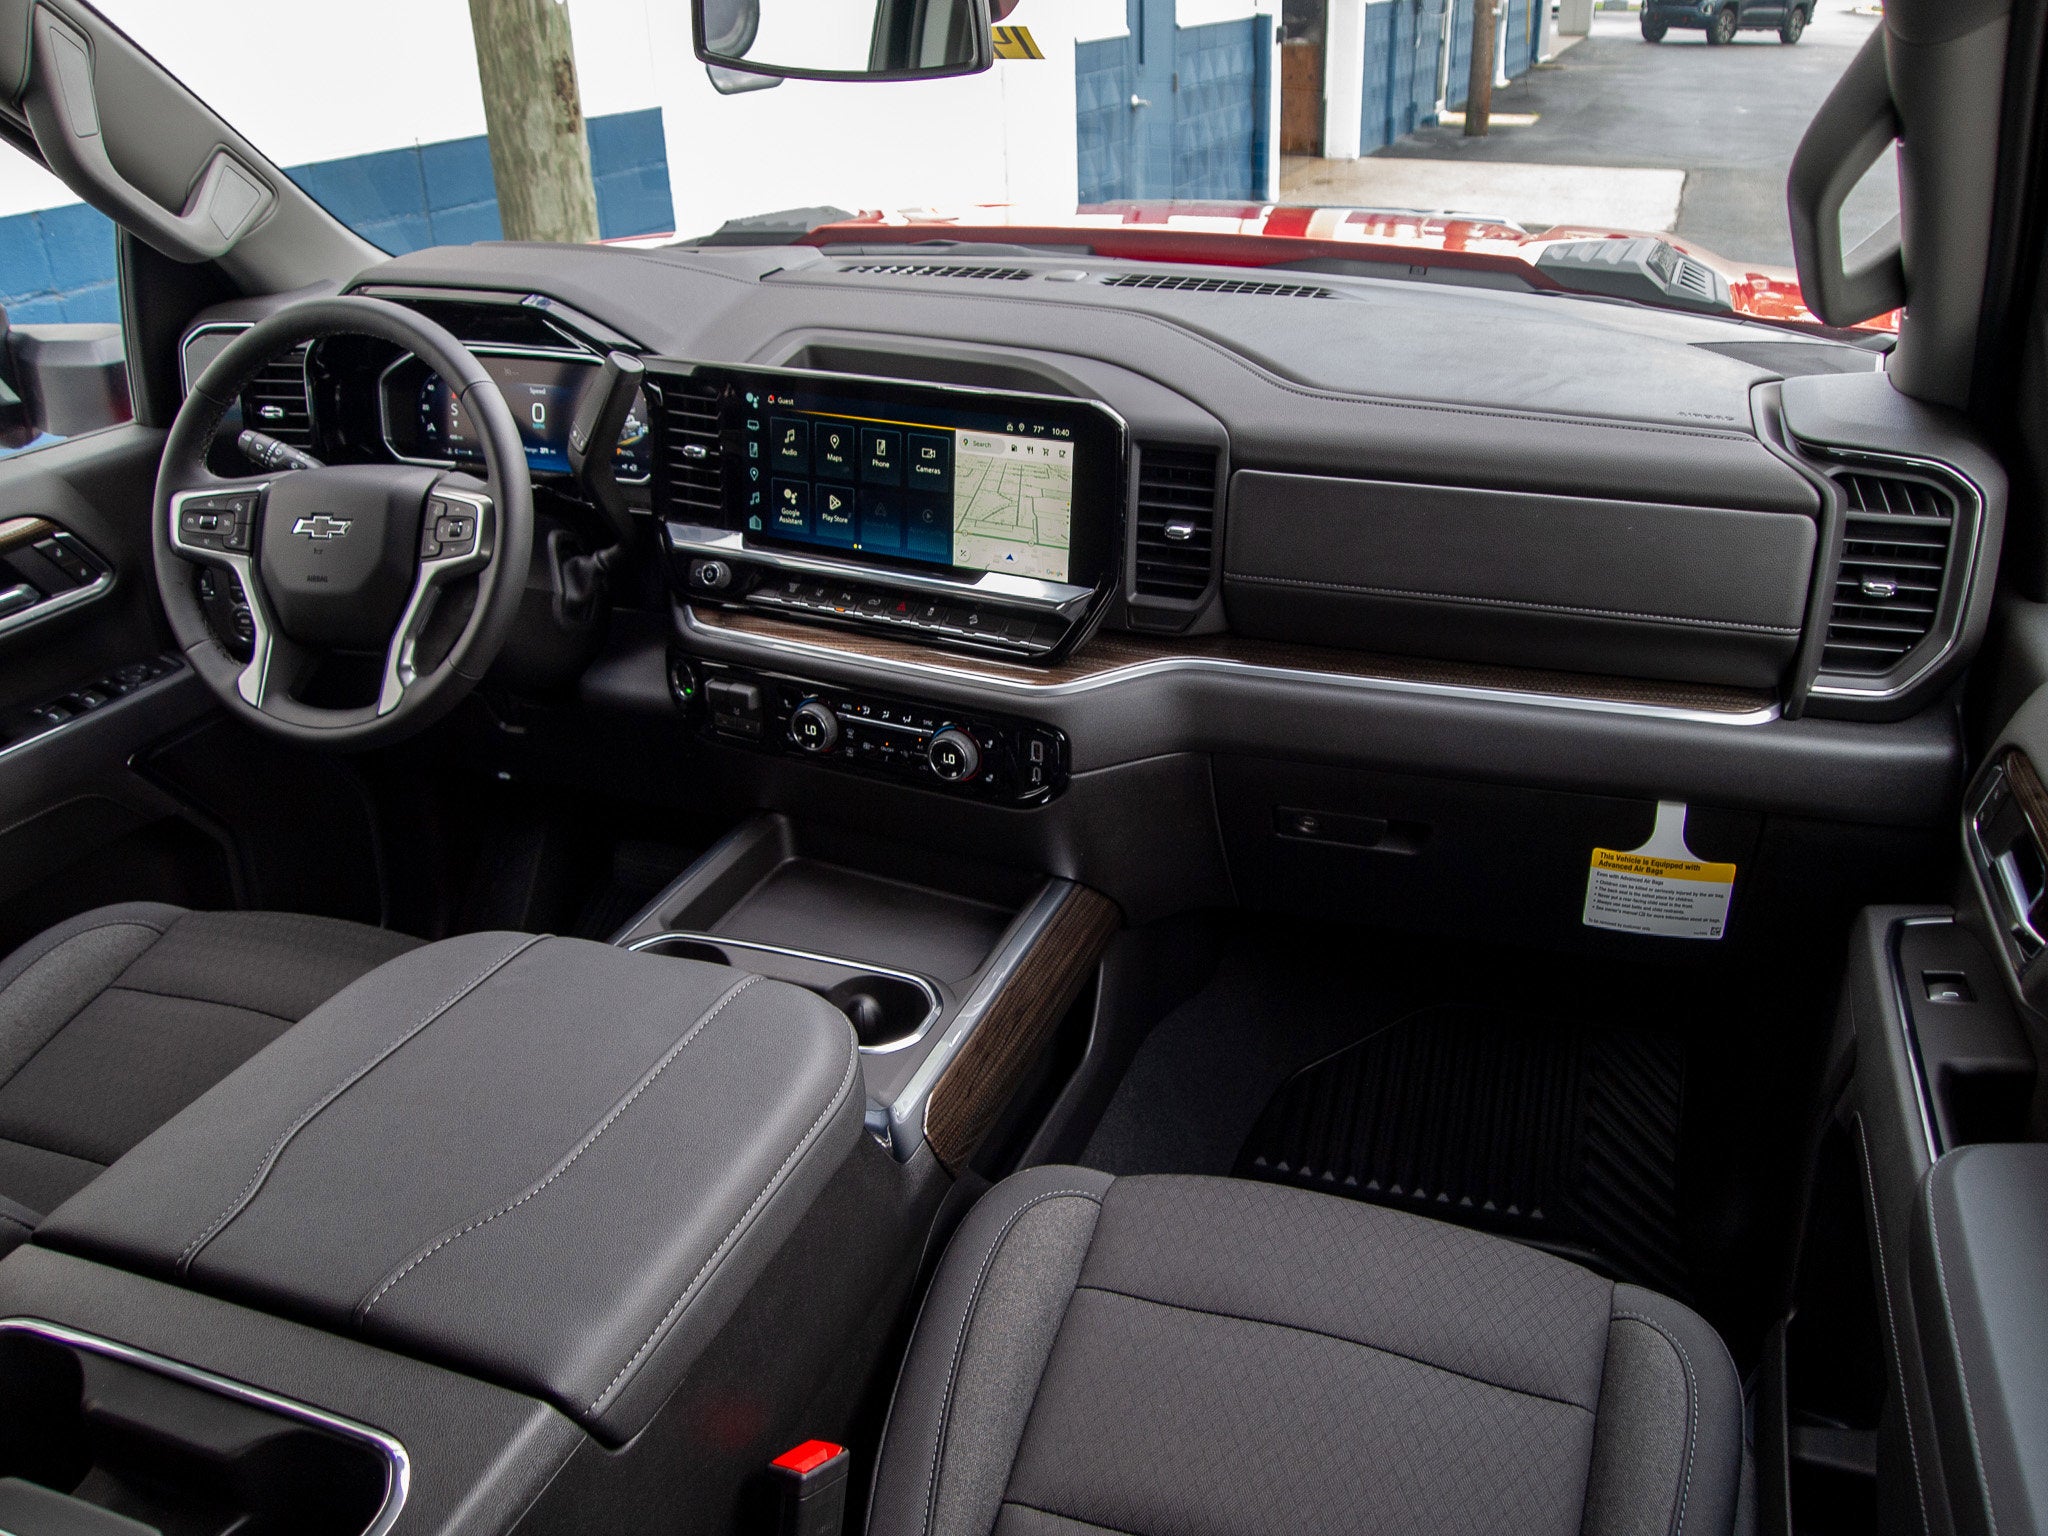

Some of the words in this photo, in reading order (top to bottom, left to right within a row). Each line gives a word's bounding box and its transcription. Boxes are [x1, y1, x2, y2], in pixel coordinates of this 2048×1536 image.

[530, 386, 546, 395] Speed
[777, 396, 794, 406] Guest
[450, 402, 459, 416] S
[531, 402, 545, 422] 0
[1052, 426, 1070, 436] 10:40
[972, 440, 991, 448] Search
[781, 447, 798, 456] Audio
[826, 452, 843, 463] Maps
[872, 458, 890, 468] Phone
[915, 463, 941, 474] Cameras
[781, 506, 800, 517] Google
[778, 515, 803, 525] Assistant
[822, 512, 833, 522] Play
[834, 514, 848, 523] Store
[1046, 568, 1063, 576] Google
[306, 574, 328, 582] AIRBAG
[804, 724, 816, 736] LO
[942, 752, 955, 764] LO
[1600, 851, 1614, 860] This
[1616, 853, 1641, 864] Vehicle
[1650, 859, 1683, 870] Equipped
[1684, 863, 1700, 871] with
[1598, 859, 1632, 870] Advanced
[1633, 864, 1644, 872] Air
[1645, 866, 1663, 876] Bags
[1620, 874, 1643, 882] Advanced
